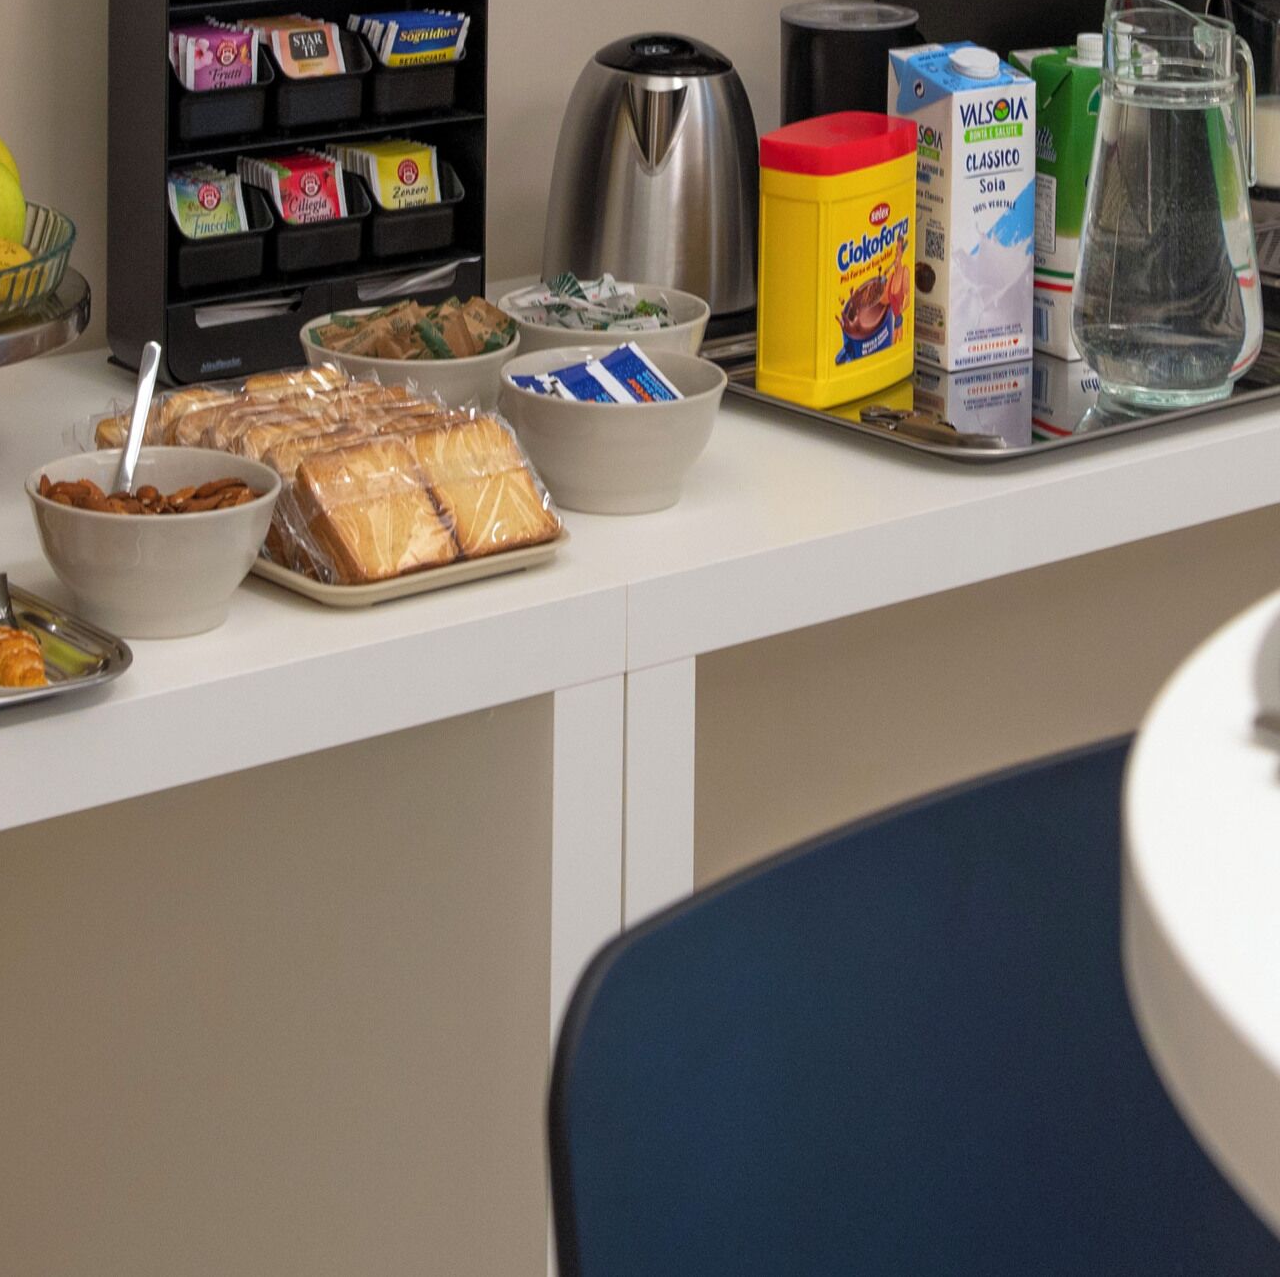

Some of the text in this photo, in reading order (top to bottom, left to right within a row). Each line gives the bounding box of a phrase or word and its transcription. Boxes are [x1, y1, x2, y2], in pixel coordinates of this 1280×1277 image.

[292, 32, 323, 47] STAR
[208, 68, 243, 81] Frutti
[960, 96, 1029, 128] VALSOIA
[918, 124, 943, 150] SOIA
[965, 148, 1021, 173] CLASSICO
[391, 185, 429, 199] Zenzero
[979, 176, 1007, 194] Soia
[289, 196, 327, 215] Ciliegia
[870, 205, 890, 224] selex
[972, 198, 1017, 215] 100% VEGETALE
[837, 217, 910, 272] Ciokoforza
